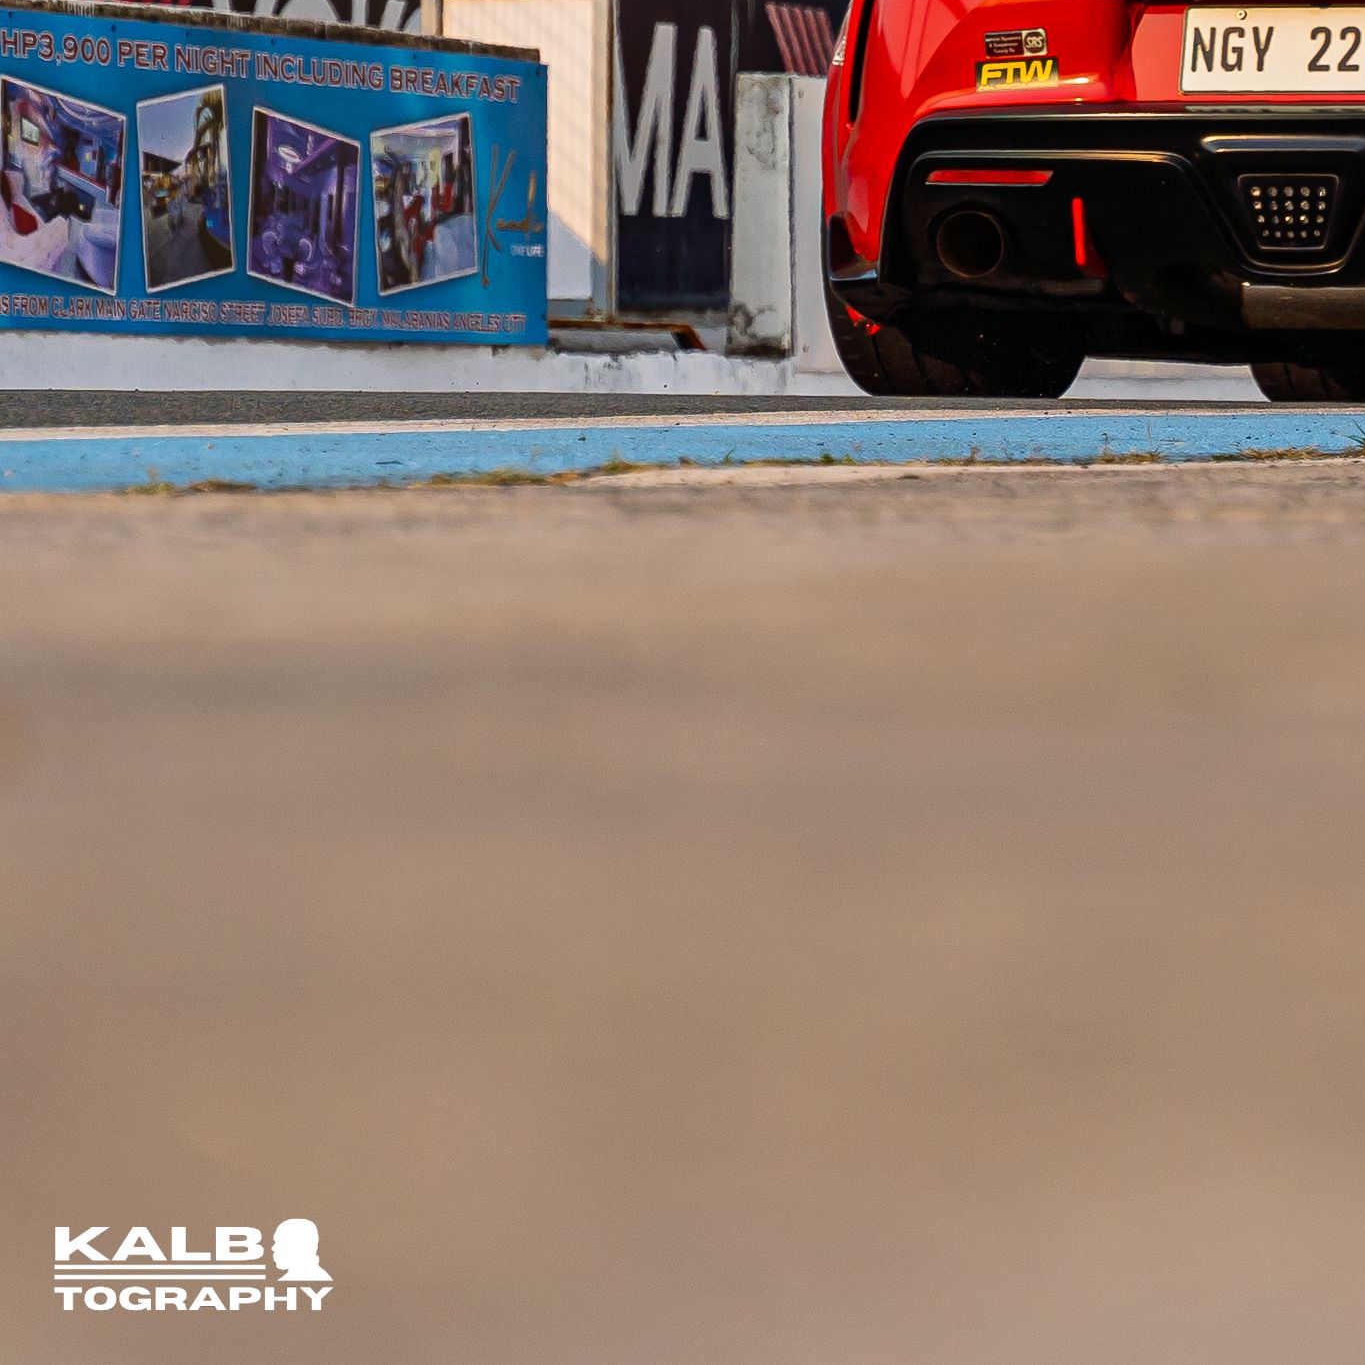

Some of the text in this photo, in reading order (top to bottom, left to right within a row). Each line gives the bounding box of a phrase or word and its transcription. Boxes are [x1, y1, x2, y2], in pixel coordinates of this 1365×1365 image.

[1191, 26, 1274, 72] NGY
[117, 40, 169, 71] PER
[174, 45, 250, 78] NIGHT
[255, 53, 384, 90] INCLUDING
[390, 66, 520, 103] BREAKFAST
[981, 60, 1053, 87] FTW
[12, 294, 49, 318] FROM
[51, 295, 92, 320] CLARK
[95, 297, 126, 321] MAIN
[128, 298, 161, 322] GATE
